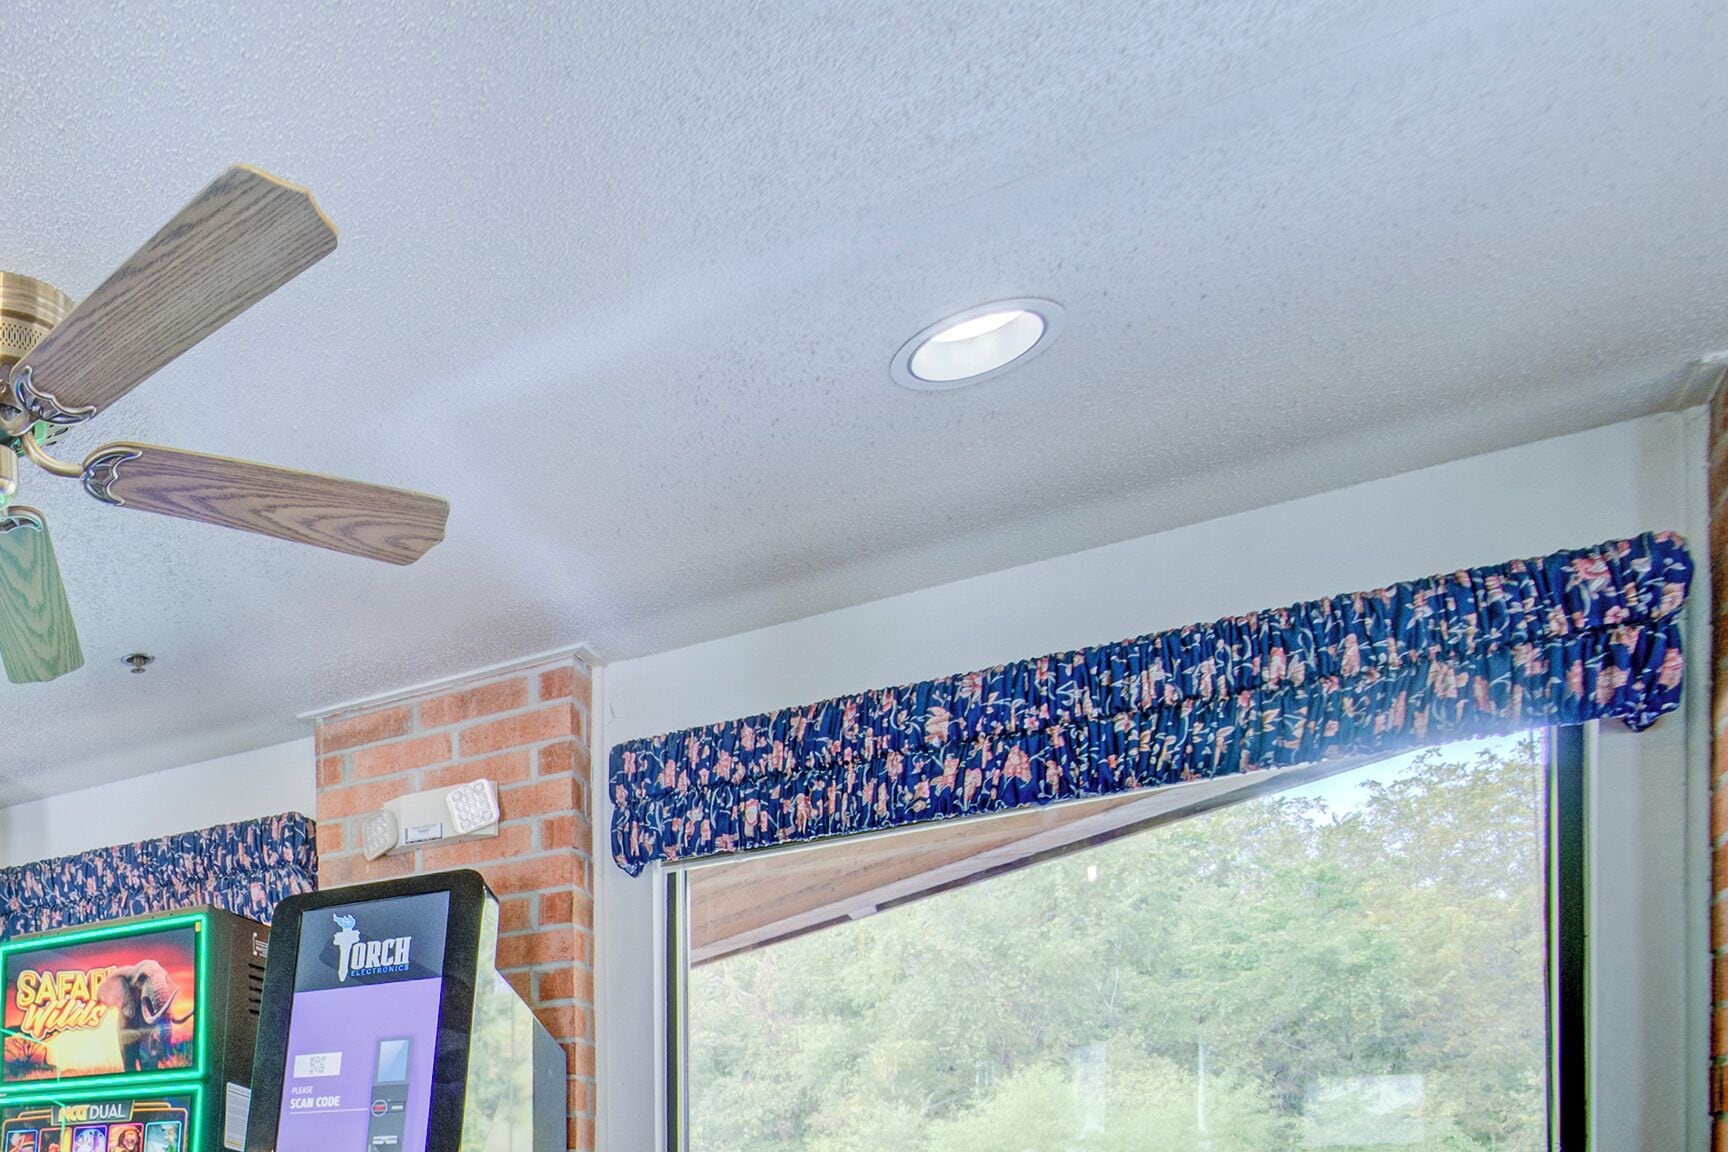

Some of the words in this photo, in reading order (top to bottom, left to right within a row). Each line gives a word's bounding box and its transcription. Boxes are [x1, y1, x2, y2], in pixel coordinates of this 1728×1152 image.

[351, 963, 410, 977] ELECTRONICS
[23, 999, 107, 1038] Wilds
[291, 1085, 313, 1095] PLEASE
[289, 1097, 314, 1109] SCAN
[315, 1095, 341, 1108] CODE
[89, 1103, 126, 1120] DUAL
